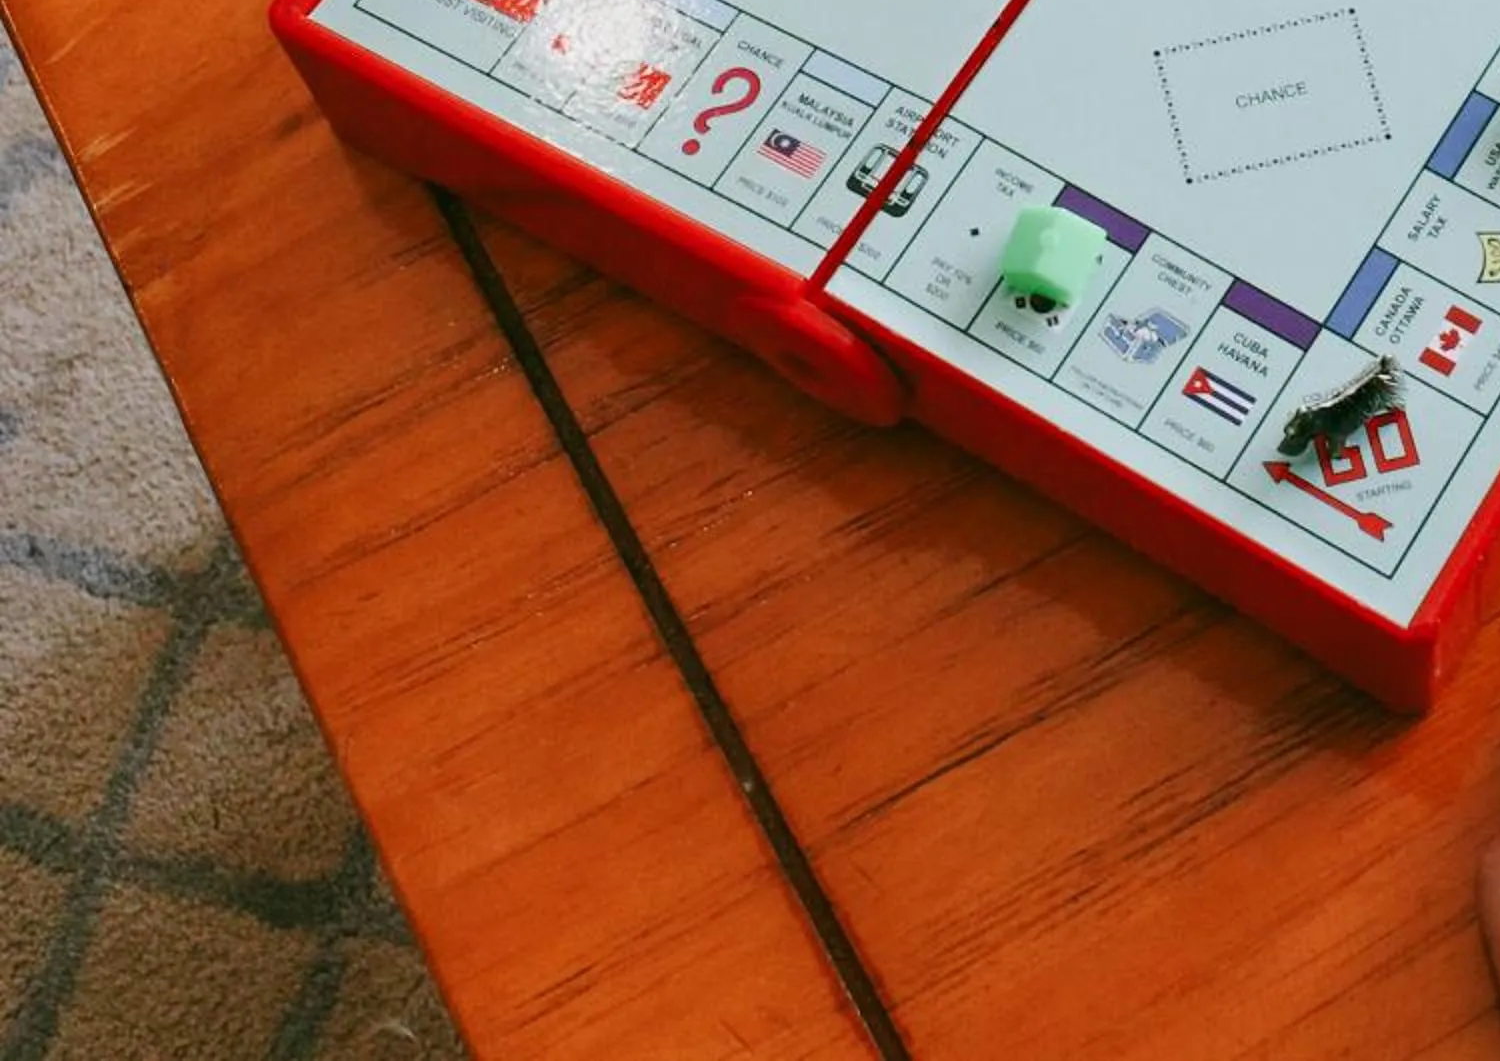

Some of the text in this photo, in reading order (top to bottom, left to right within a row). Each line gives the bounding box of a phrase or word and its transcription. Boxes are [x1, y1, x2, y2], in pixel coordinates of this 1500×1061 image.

[461, 3, 517, 41] VISITING
[736, 38, 784, 69] CHANCE
[796, 91, 855, 130] MALAYSIA
[1233, 80, 1308, 110] CHANCE
[892, 103, 962, 149] AIRPORT
[994, 166, 1034, 194] INCOME
[1406, 192, 1443, 244] SALARY
[1427, 215, 1448, 240] TAX
[1150, 253, 1213, 293] COMMUNITY
[1156, 271, 1192, 297] CHEST
[1373, 283, 1412, 339] CANADA
[1388, 293, 1425, 346] OTTAWA
[1216, 340, 1270, 378] HAVANA
[1231, 330, 1270, 359] CUBA
[1314, 408, 1420, 488] GO
[1355, 478, 1411, 501] STARTING
